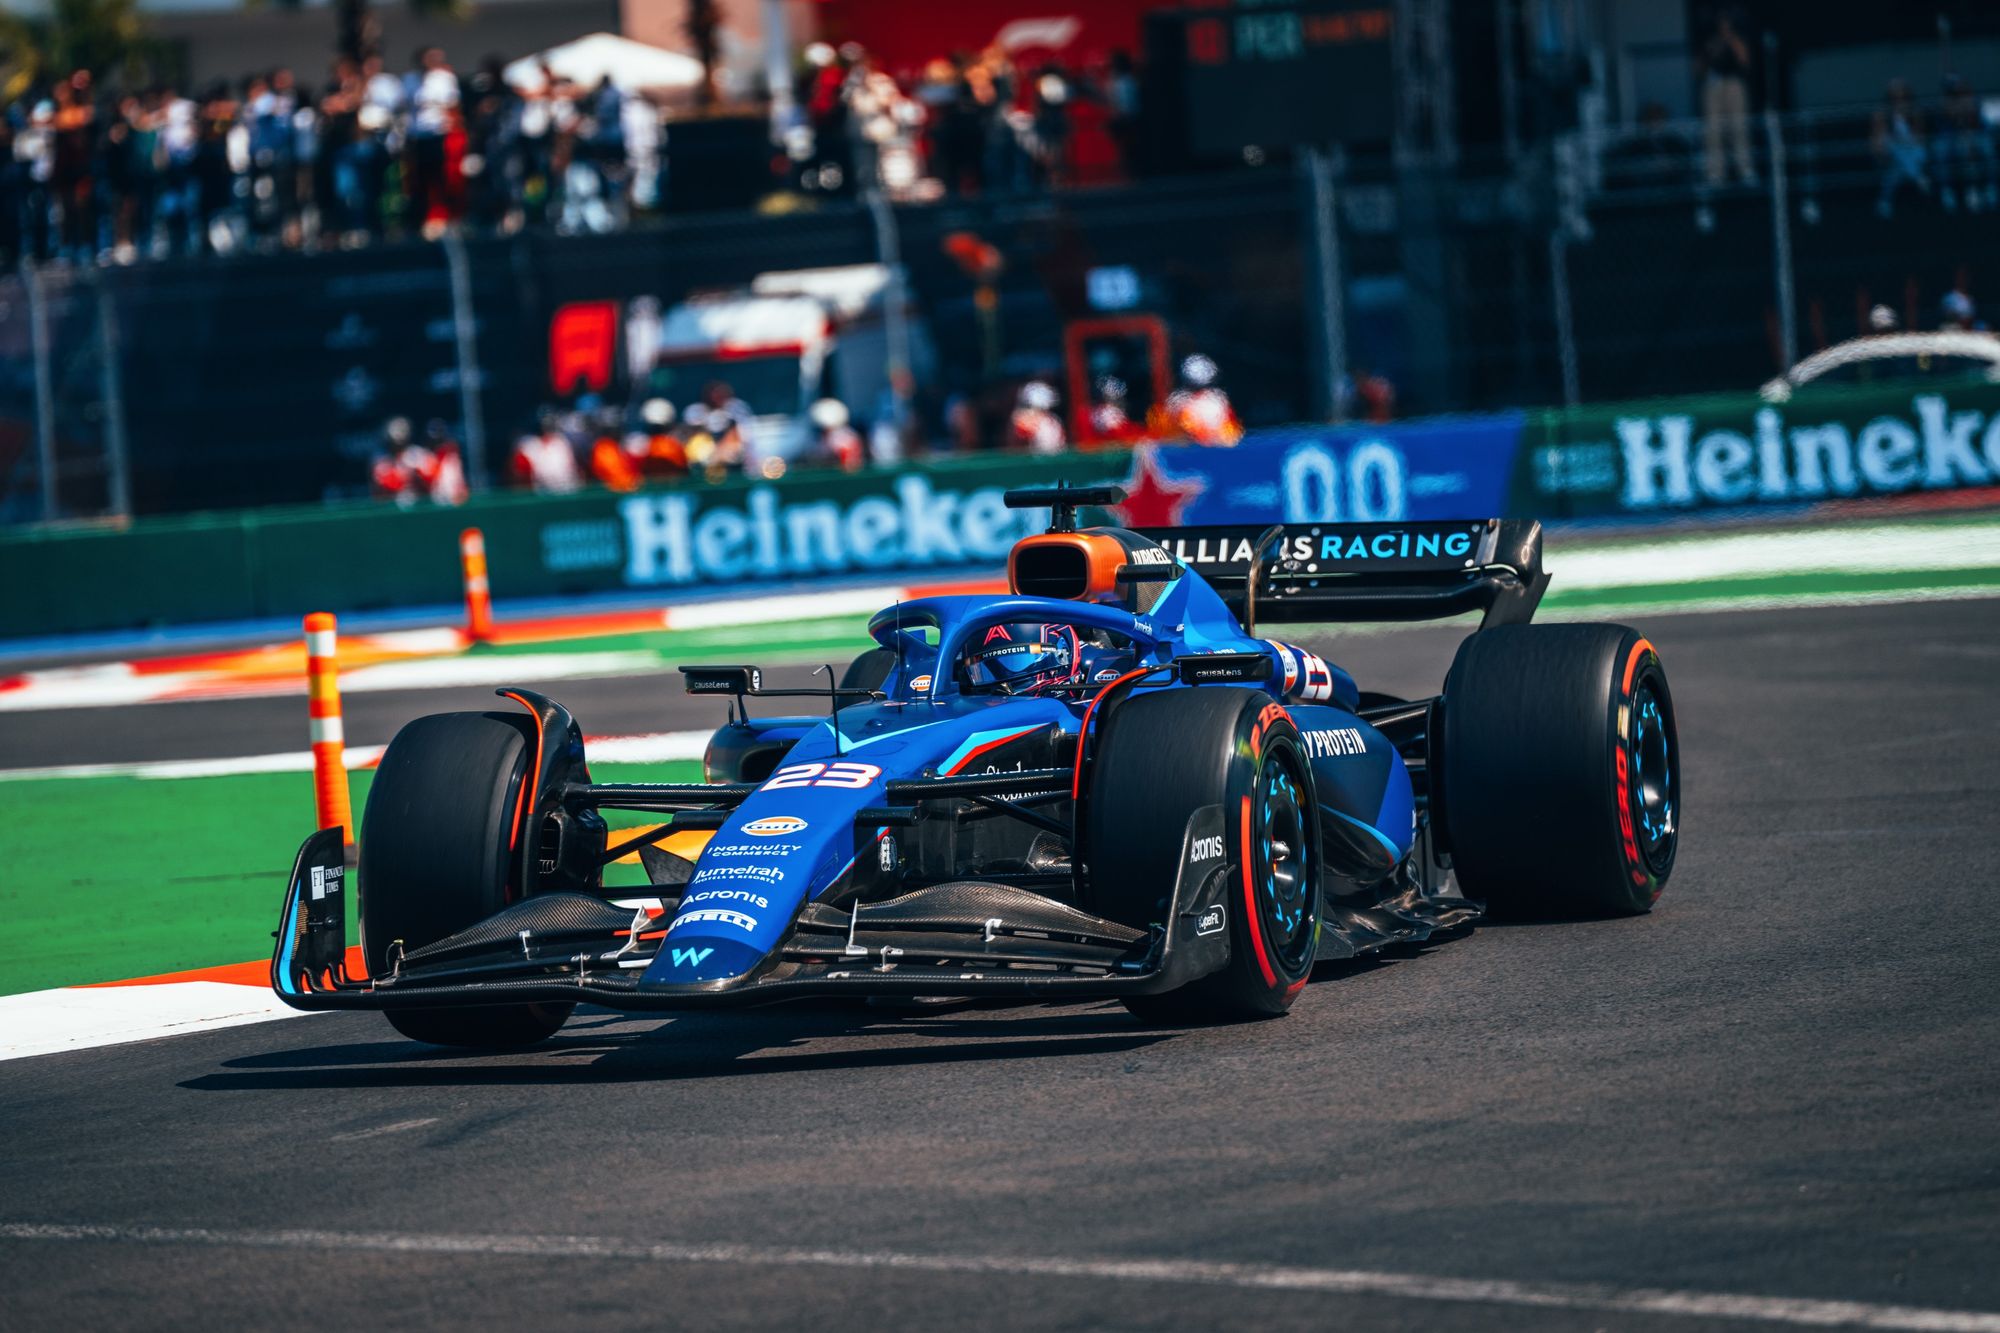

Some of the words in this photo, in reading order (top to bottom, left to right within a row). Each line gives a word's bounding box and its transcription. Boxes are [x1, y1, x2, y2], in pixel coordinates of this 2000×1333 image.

[1613, 394, 2000, 507] Heinek
[1320, 531, 1471, 559] RACING
[982, 646, 1026, 658] MYPROTEIN
[1196, 668, 1242, 677] causaLens
[1302, 728, 1367, 759] YPROTEIN
[759, 762, 883, 793] 23
[707, 844, 802, 854] INGENUITY
[1190, 836, 1223, 863] Acronis
[678, 890, 768, 908] Acronis
[667, 909, 758, 932] PIRELLI
